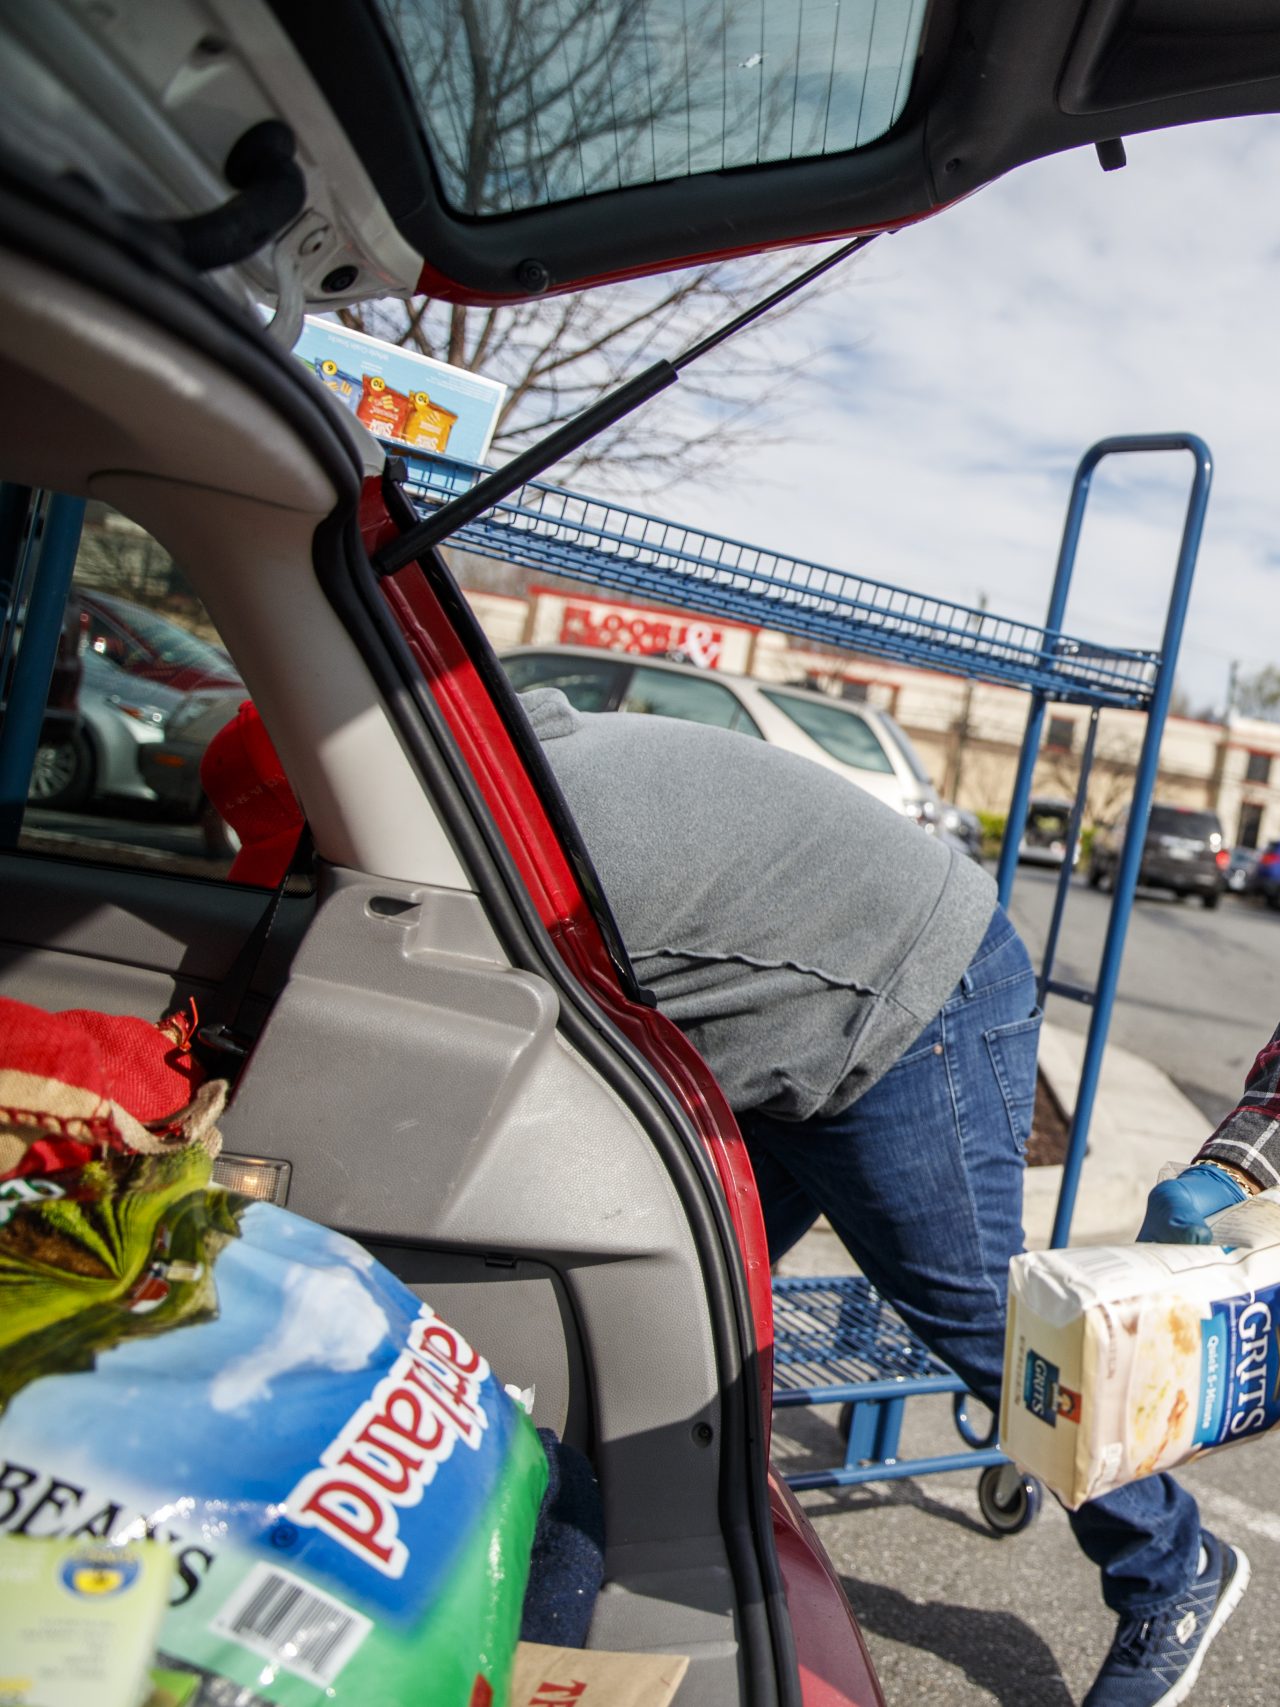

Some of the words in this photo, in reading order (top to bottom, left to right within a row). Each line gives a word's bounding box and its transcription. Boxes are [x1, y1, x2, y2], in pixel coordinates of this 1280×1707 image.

[1032, 1359, 1048, 1415] GRITS
[1207, 1335, 1219, 1374] Quick
[1230, 1301, 1272, 1435] GRITS
[301, 1314, 482, 1564] artland
[0, 1461, 214, 1608] BEAS
